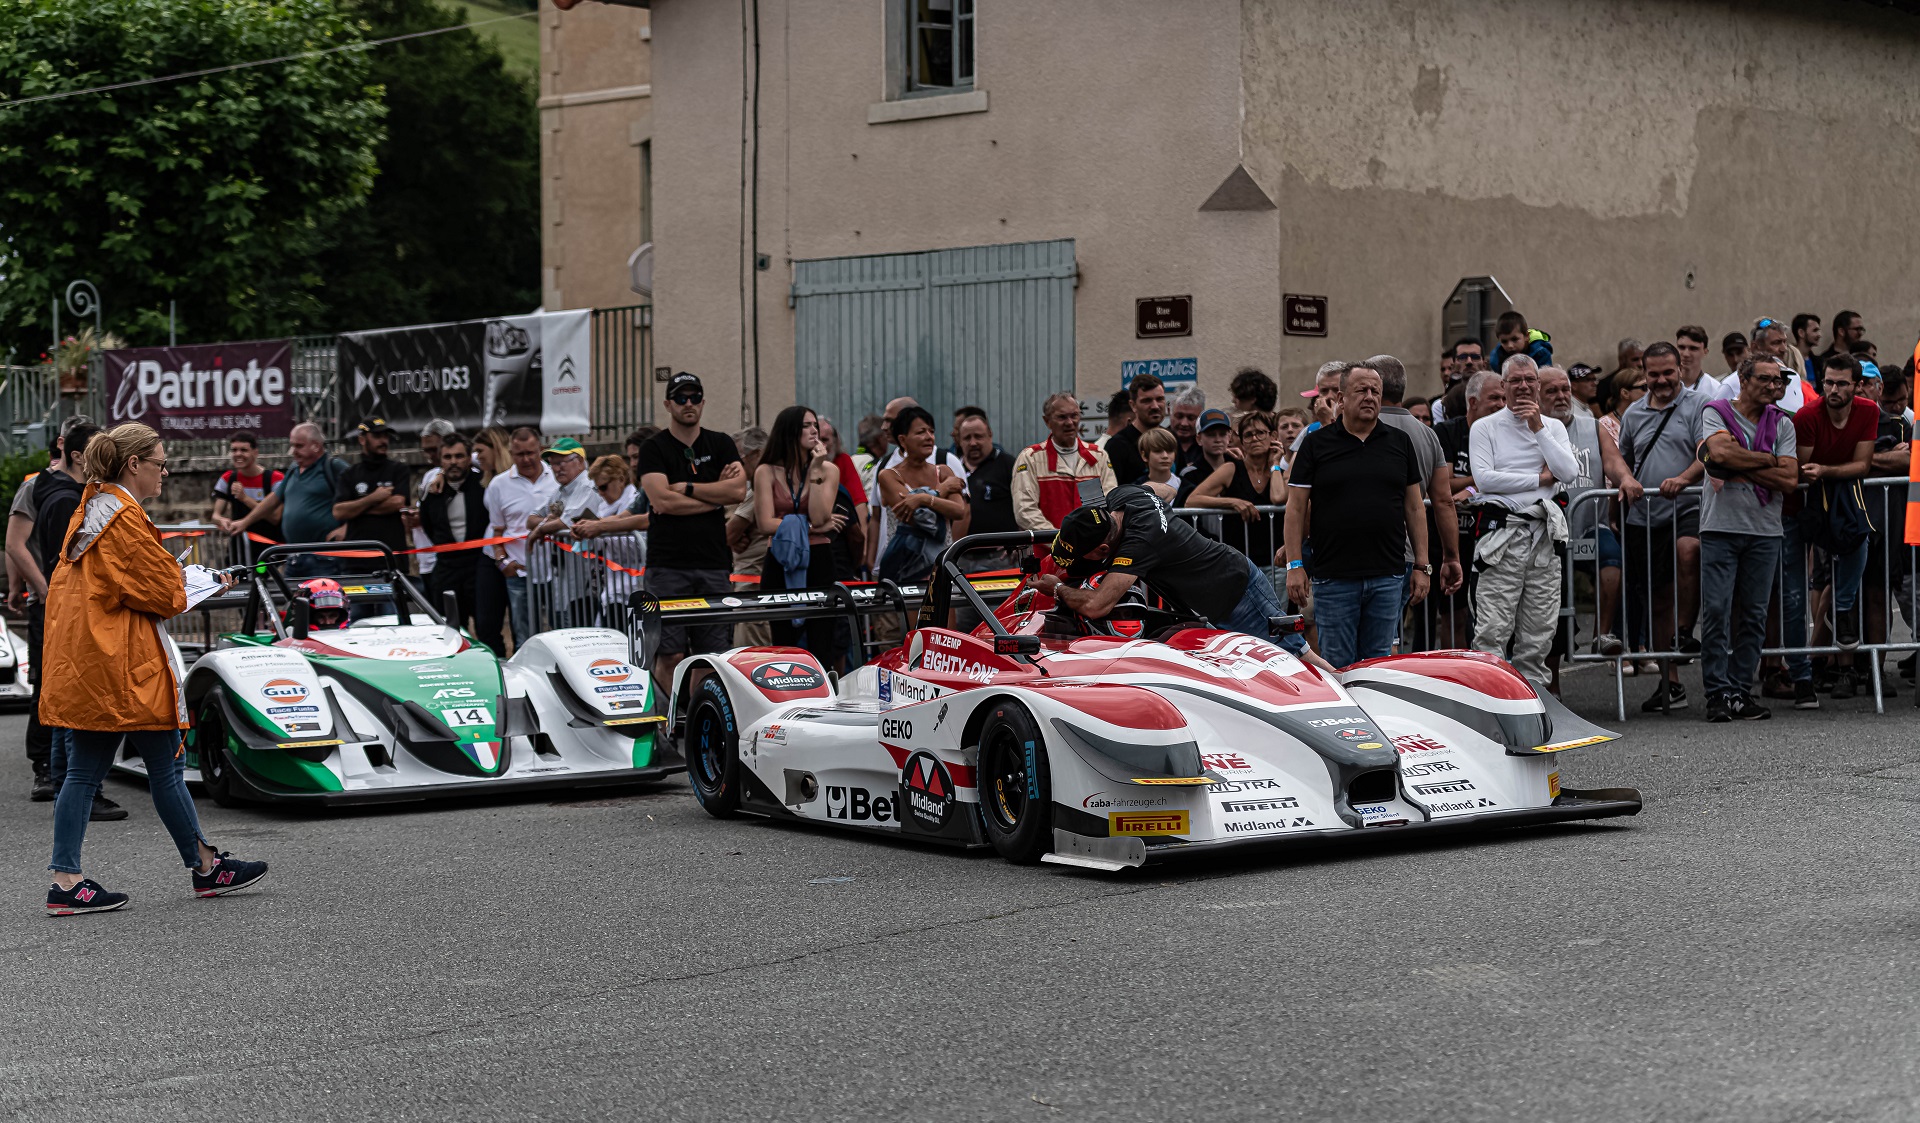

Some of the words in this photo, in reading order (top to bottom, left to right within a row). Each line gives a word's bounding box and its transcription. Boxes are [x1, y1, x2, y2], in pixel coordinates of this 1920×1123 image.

[1155, 306, 1170, 316] Rue
[1145, 321, 1157, 330] des
[1122, 361, 1147, 379] WC
[1148, 361, 1196, 377] Publics
[138, 356, 285, 409] Patriote
[441, 366, 470, 391] DS3
[757, 591, 824, 605] ZEMP
[627, 607, 646, 669] 15
[934, 633, 963, 650] M.ZEMP
[997, 645, 1020, 653] ONE
[589, 666, 631, 677] Gulf
[922, 648, 1000, 686] EIGHTY-ONE
[767, 675, 815, 687] Midland
[892, 674, 927, 702] Midland
[263, 686, 307, 697] Gulf
[432, 688, 477, 700] ARS
[598, 686, 619, 694] Race
[619, 684, 641, 692] Fuels
[270, 706, 292, 714] Race
[292, 705, 316, 713] Fuels
[702, 678, 735, 733] Cinturato
[453, 709, 485, 725] 14
[1326, 717, 1368, 726] Beta
[882, 718, 913, 740] GEKO
[1024, 740, 1040, 800] PIRELLI
[1202, 758, 1252, 770] NE
[1411, 779, 1477, 796] PIRELLI
[850, 787, 901, 823] Bet
[910, 791, 945, 817] Midland
[1090, 796, 1168, 809] zaba-fahrzeuge.ch
[1220, 796, 1300, 813] PIRELLI
[1356, 805, 1387, 815] GEKO
[1425, 800, 1474, 814] Midland
[1115, 815, 1182, 832] PIRELLI
[1362, 813, 1380, 821] uper
[1224, 818, 1286, 833] Midland
[215, 871, 236, 885] N
[74, 887, 97, 903] N
